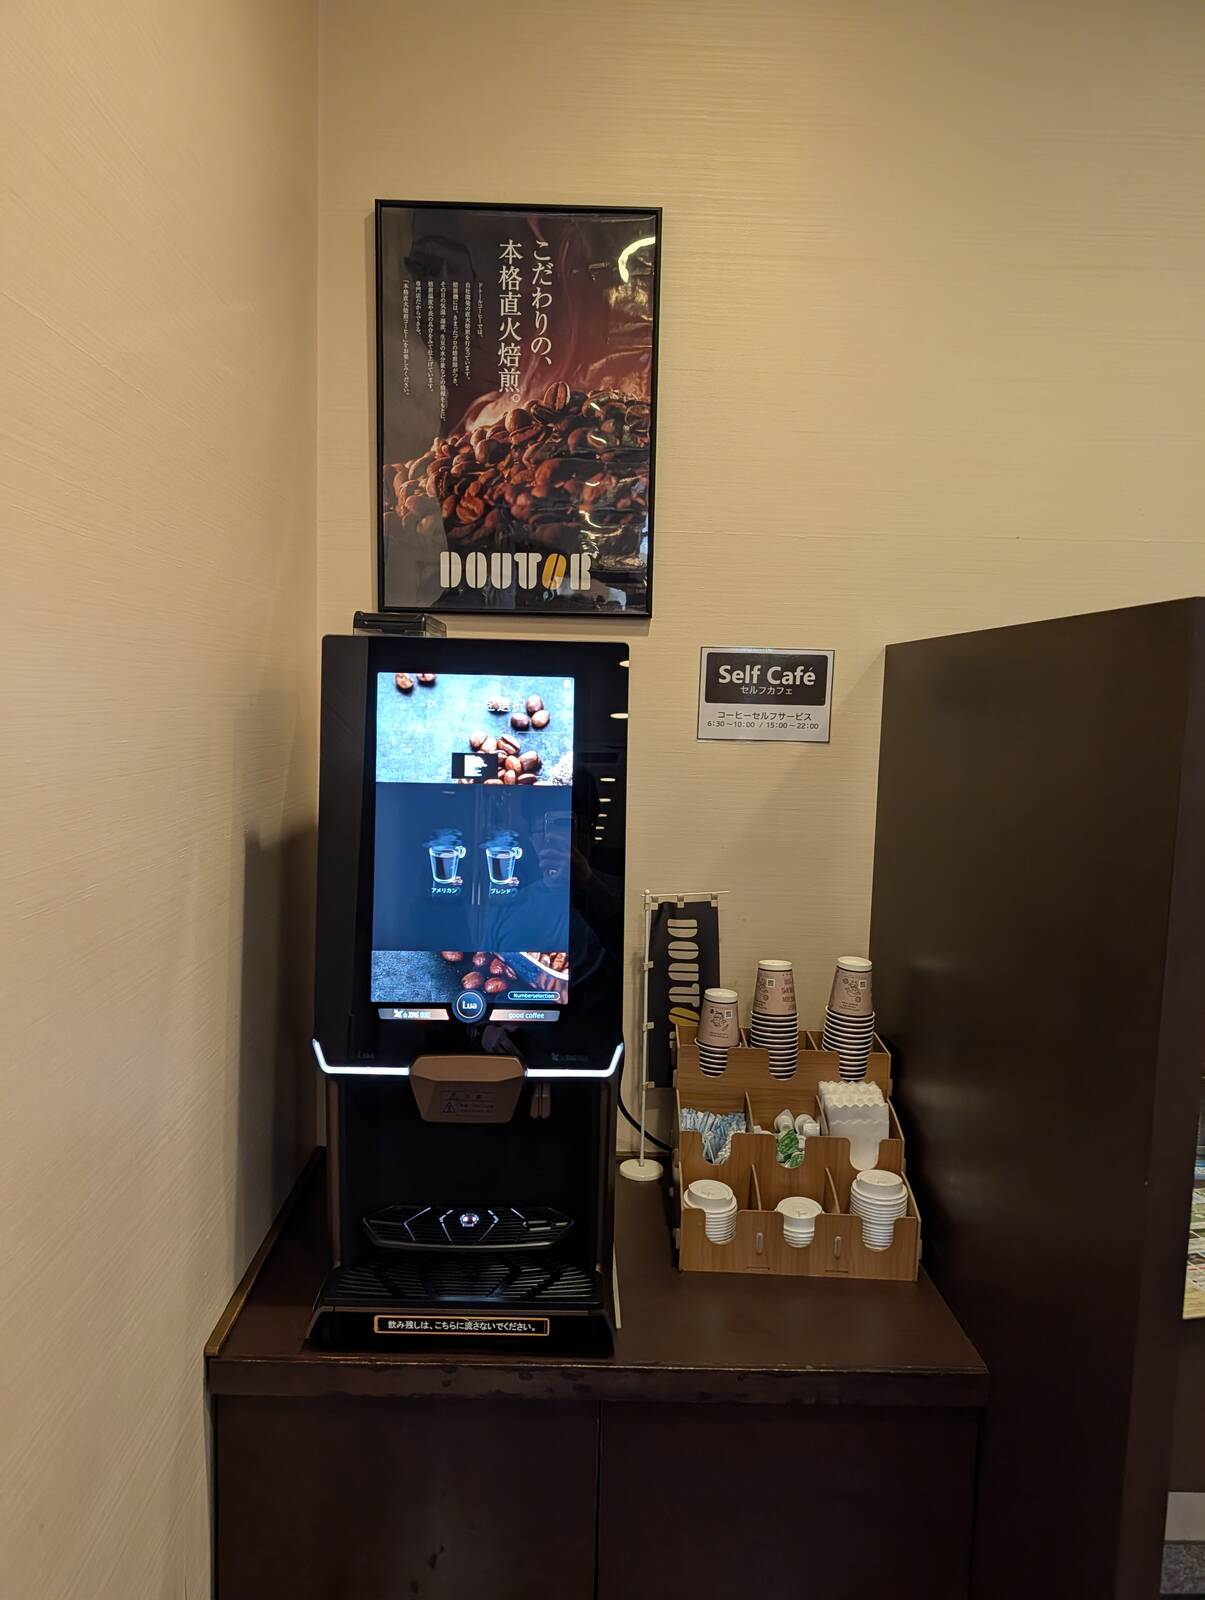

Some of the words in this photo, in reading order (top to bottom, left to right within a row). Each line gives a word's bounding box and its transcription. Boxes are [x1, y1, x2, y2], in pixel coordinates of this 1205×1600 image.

[531, 240, 554, 365] こだわりの、
[498, 239, 523, 403] 本格直火焙煎。
[440, 551, 592, 591] DOUTOR
[718, 664, 761, 684] Self
[767, 665, 816, 686] Café
[740, 685, 793, 696] セルフカフェ
[717, 711, 813, 721] コーヒーセルフサービス
[490, 887, 512, 895] ブレンド
[667, 918, 700, 1049] DOUTO
[462, 1000, 477, 1010] Lua
[509, 1012, 524, 1021] good
[525, 1012, 544, 1020] coffee
[387, 1320, 536, 1332] 飲み残しは、こちらに流さないでください。
